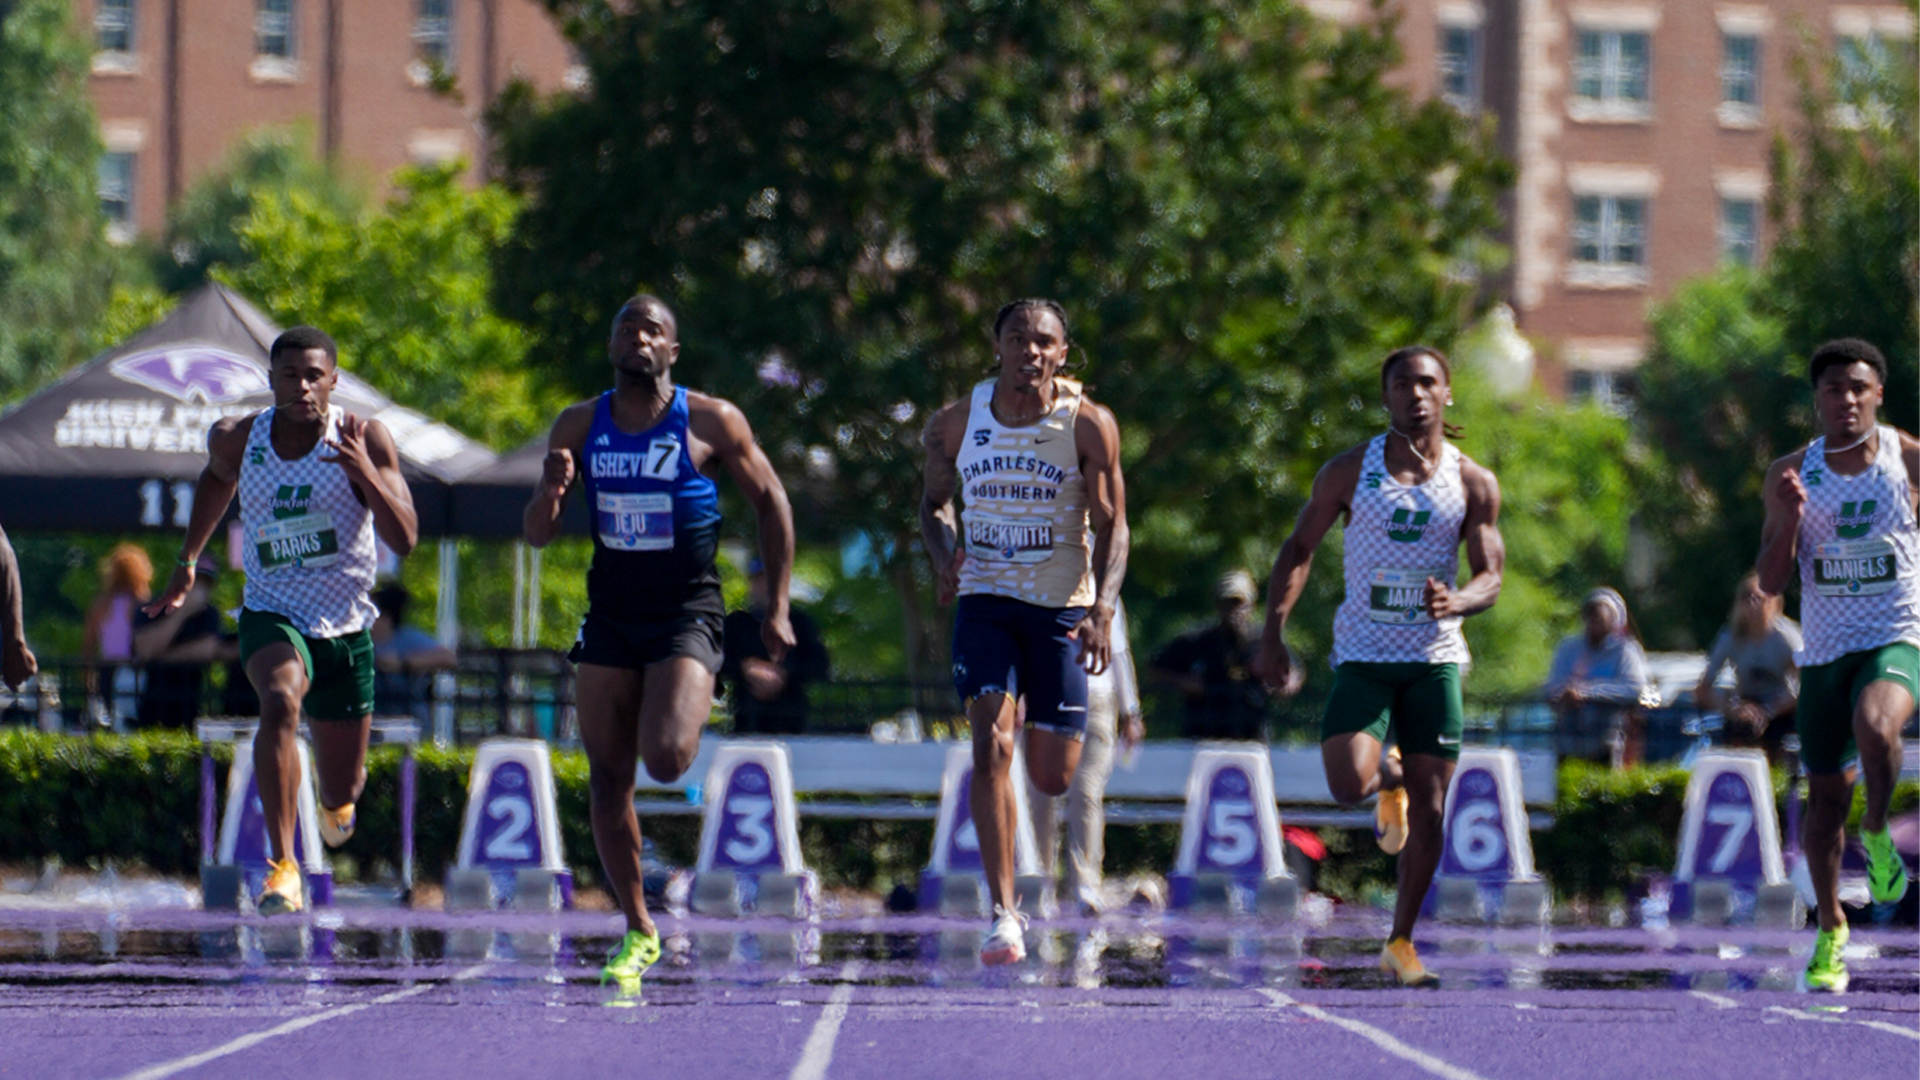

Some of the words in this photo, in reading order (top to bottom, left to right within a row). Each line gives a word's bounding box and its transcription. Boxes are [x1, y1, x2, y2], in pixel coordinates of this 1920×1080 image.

[653, 443, 675, 474] 7
[963, 455, 1067, 485] CHARLESTON
[270, 533, 322, 560] PARKS
[972, 521, 1051, 547] BECKWITH
[1822, 556, 1888, 579] DANIELS
[1386, 587, 1427, 607] JAME
[486, 795, 533, 860] 2
[723, 795, 775, 865] 3
[1205, 801, 1259, 866] 5
[1451, 799, 1506, 872] 6
[1706, 802, 1753, 873] 7
